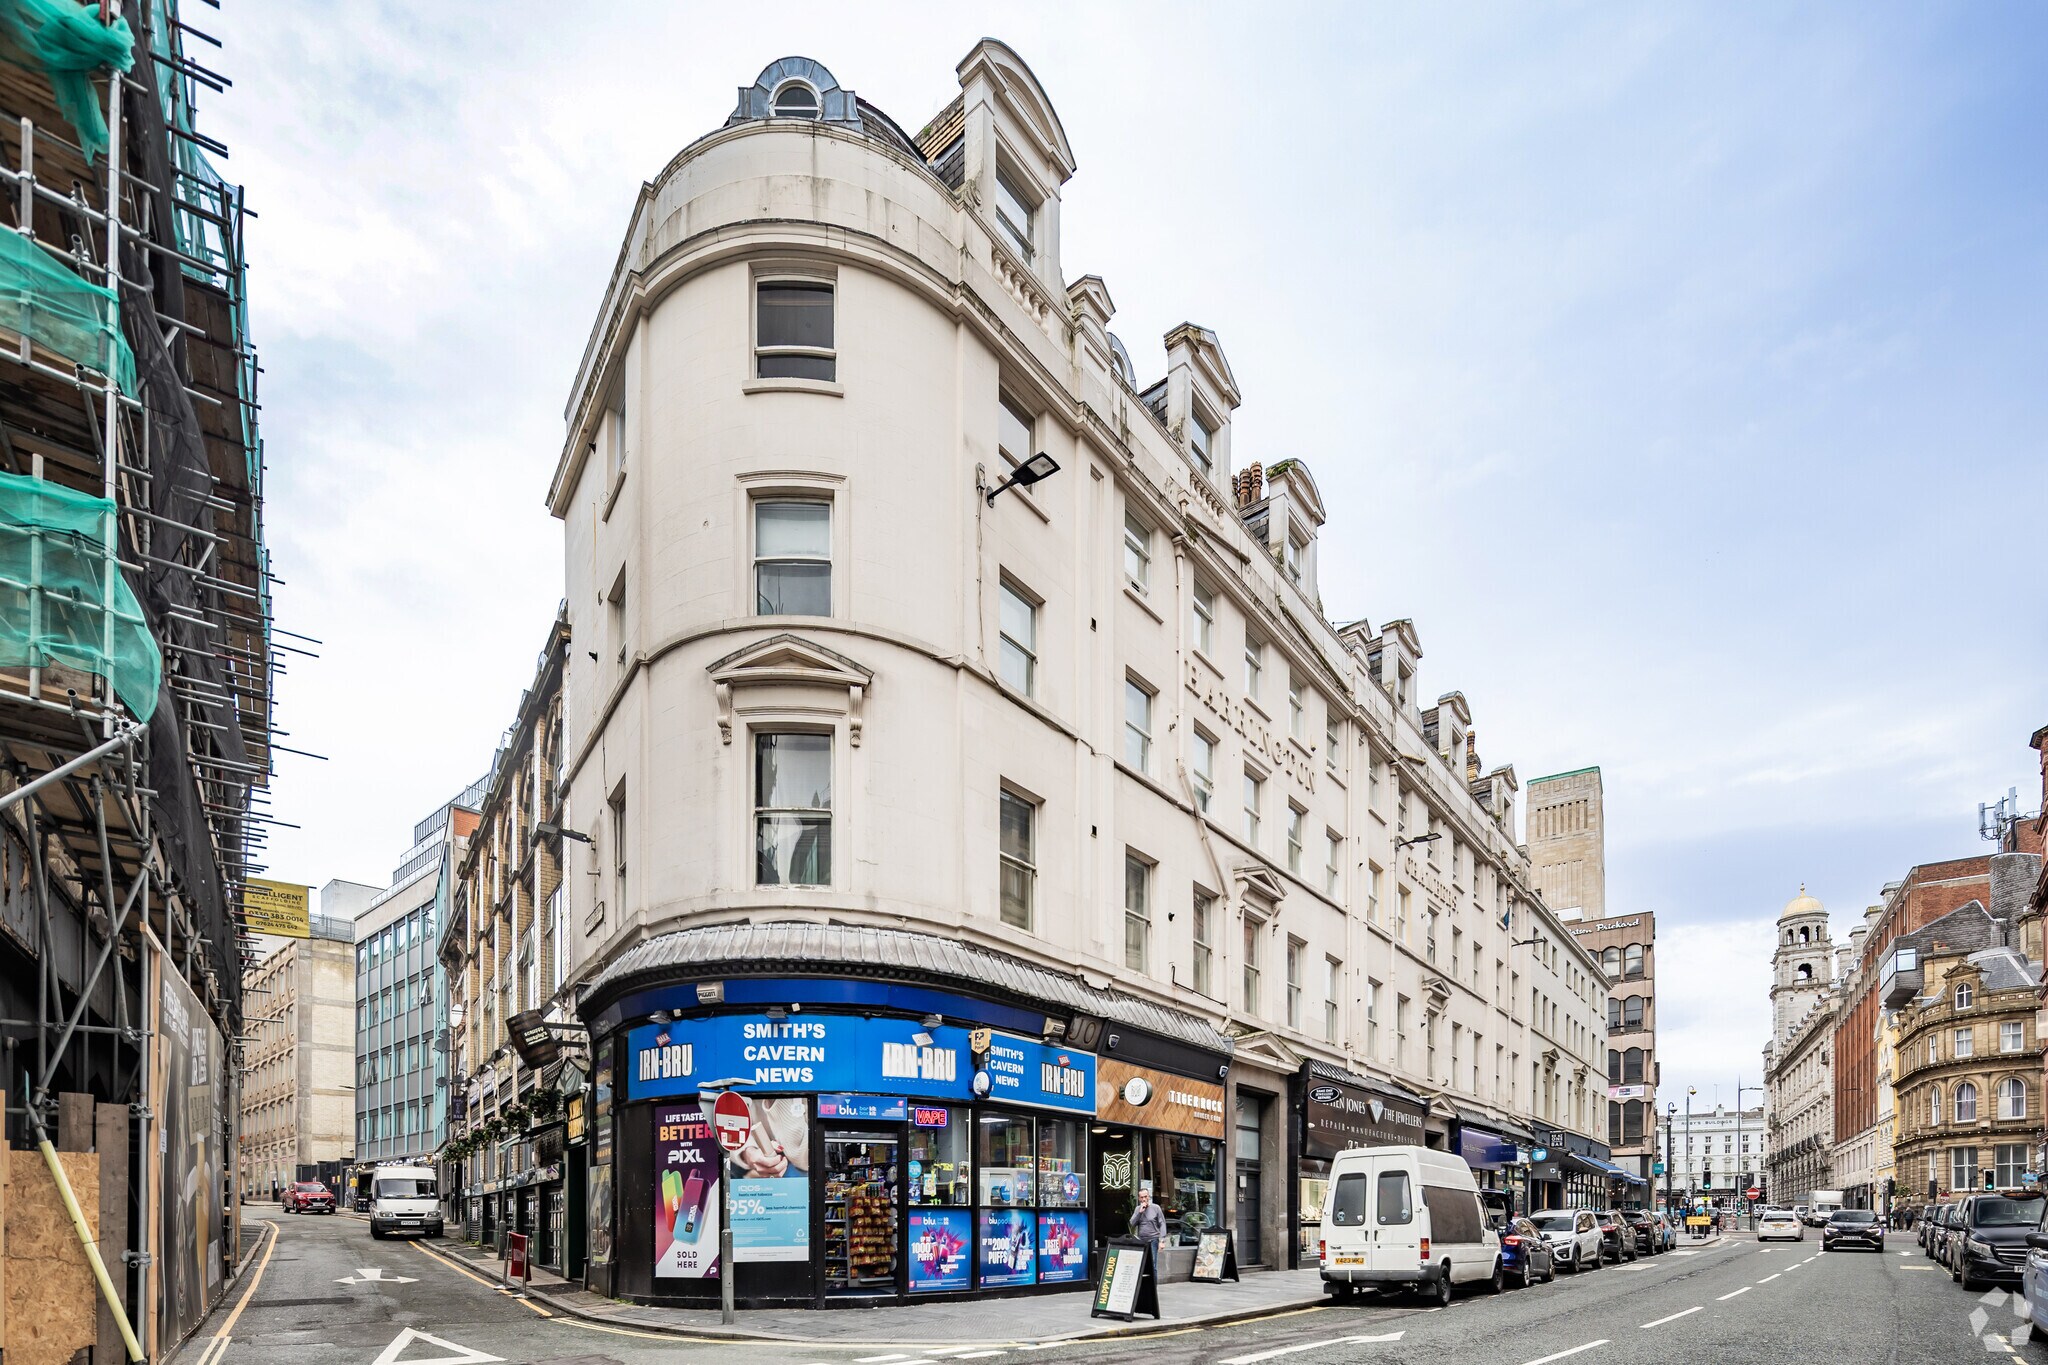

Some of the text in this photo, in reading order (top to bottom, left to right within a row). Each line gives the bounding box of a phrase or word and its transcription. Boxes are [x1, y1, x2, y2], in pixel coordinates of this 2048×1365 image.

[1184, 658, 1317, 796] HARRINGTON
[252, 894, 301, 905] SCAFFOLDING
[271, 912, 285, 920] 383
[1569, 918, 1640, 937] atson Prickard
[743, 1022, 826, 1040] SMITH'S
[743, 1045, 825, 1063] CAVERN
[990, 1045, 1024, 1061] SMITH'S
[755, 1067, 815, 1083] NEWS
[990, 1059, 1024, 1075] CAVERN
[995, 1074, 1020, 1088] NEWS
[1168, 1090, 1223, 1113] TIGER ROCK
[665, 1112, 706, 1123] LIFE TASTE
[916, 1110, 946, 1125] VAPE
[1346, 1098, 1366, 1115] JONES
[1384, 1107, 1395, 1122] THE
[1395, 1111, 1423, 1128] JEWELLERS
[1320, 1118, 1345, 1131] REPAIR
[668, 1148, 706, 1164] PIXL
[729, 1198, 766, 1216] 95%
[676, 1251, 698, 1259] SOLD
[917, 1253, 934, 1262] PUFFS
[988, 1251, 1009, 1265] PUFFS
[676, 1261, 698, 1269] HERE
[1099, 1256, 1117, 1304] HAPPY HOUR
